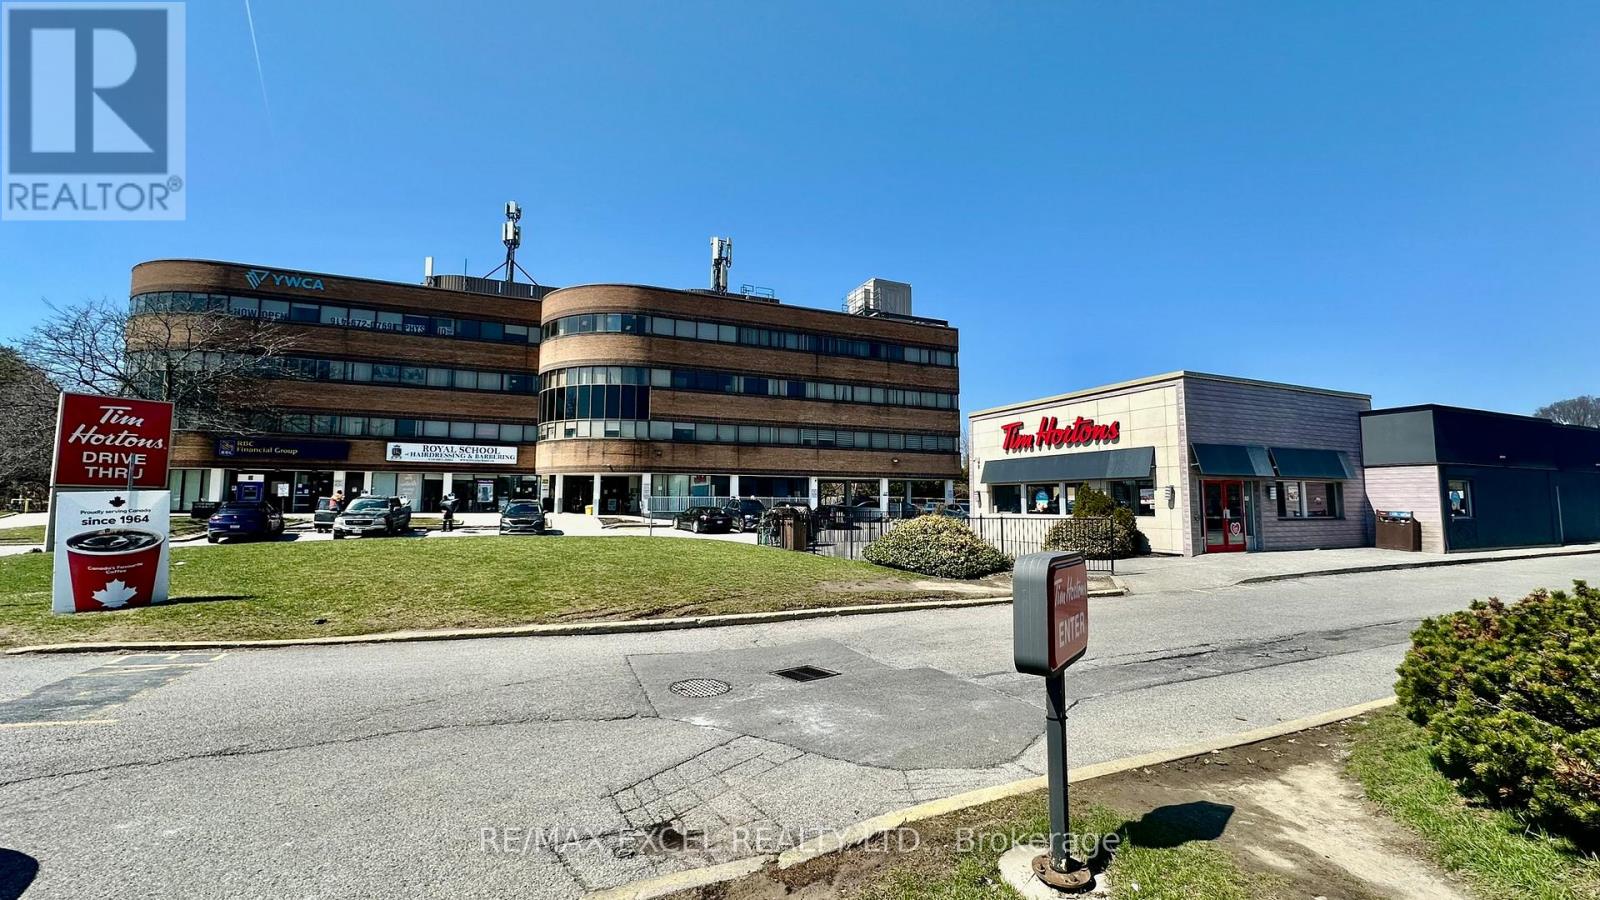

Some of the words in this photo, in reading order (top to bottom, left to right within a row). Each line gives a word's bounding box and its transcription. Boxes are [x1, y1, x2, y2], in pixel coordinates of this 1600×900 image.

[272, 273, 325, 291] YWCA
[263, 311, 288, 322] OPEN
[99, 406, 144, 427] Tim
[68, 423, 163, 449] Hortons
[1001, 421, 1034, 451] Tim
[1035, 416, 1120, 447] Hortons
[274, 447, 298, 455] Group
[422, 445, 457, 453] ROYAL
[459, 446, 500, 454] SCHOOL
[82, 451, 147, 465] DRIVE
[84, 466, 143, 479] THRU
[82, 517, 116, 526] since
[120, 514, 150, 524] 1964
[1059, 612, 1085, 649] ENTER
